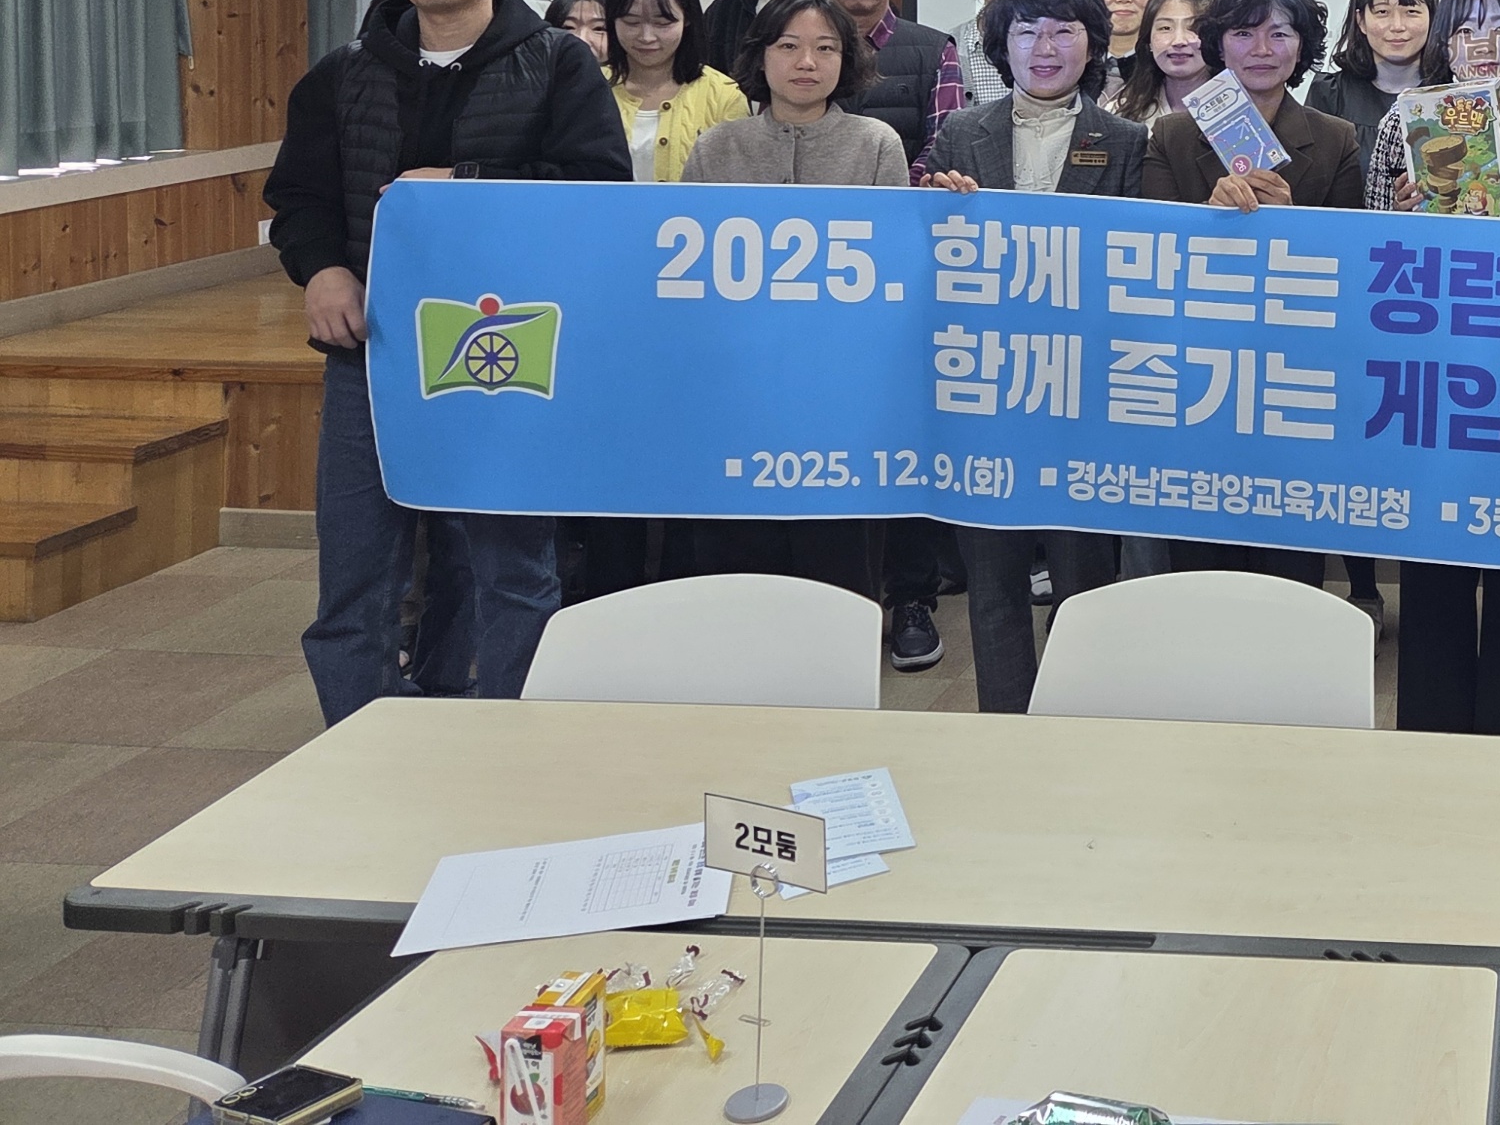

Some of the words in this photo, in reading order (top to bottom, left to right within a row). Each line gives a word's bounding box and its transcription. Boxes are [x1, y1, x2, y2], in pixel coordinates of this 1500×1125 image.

[1444, 108, 1485, 128] 우드맨
[1234, 160, 1247, 173] 26
[657, 216, 904, 303] 2025.
[932, 215, 1081, 310] 함께
[1105, 230, 1339, 328] 만드는
[933, 324, 1081, 419] 함께
[1107, 338, 1337, 441] 즐기는
[751, 452, 860, 488] 2025.
[1065, 459, 1411, 530] 경상남도함양교육지원청
[734, 822, 798, 862] 2모둠
